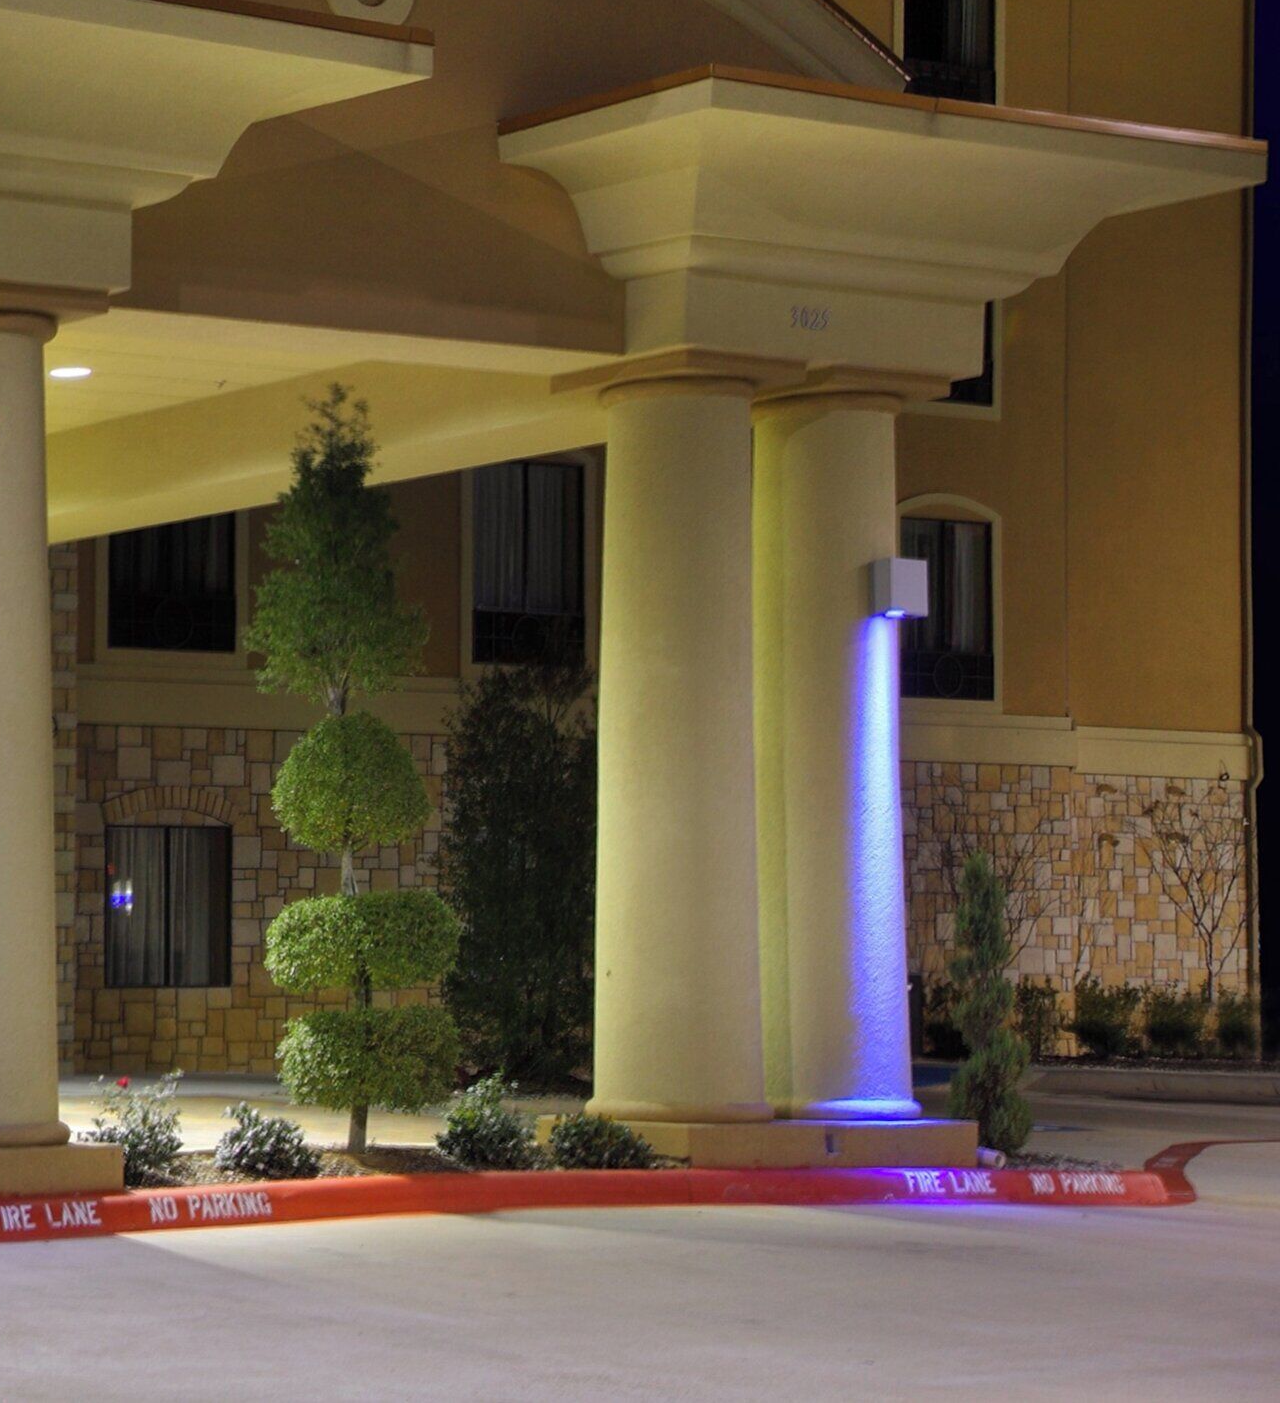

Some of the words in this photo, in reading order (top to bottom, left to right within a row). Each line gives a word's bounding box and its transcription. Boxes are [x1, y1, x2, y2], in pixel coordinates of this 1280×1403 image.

[903, 1170, 943, 1195] FIRE
[947, 1171, 996, 1195] LANE
[1028, 1172, 1056, 1196] NO
[1060, 1172, 1127, 1196] PARKING
[43, 1200, 102, 1229] LANE
[147, 1195, 179, 1225] NO
[188, 1191, 272, 1221] PARKING
